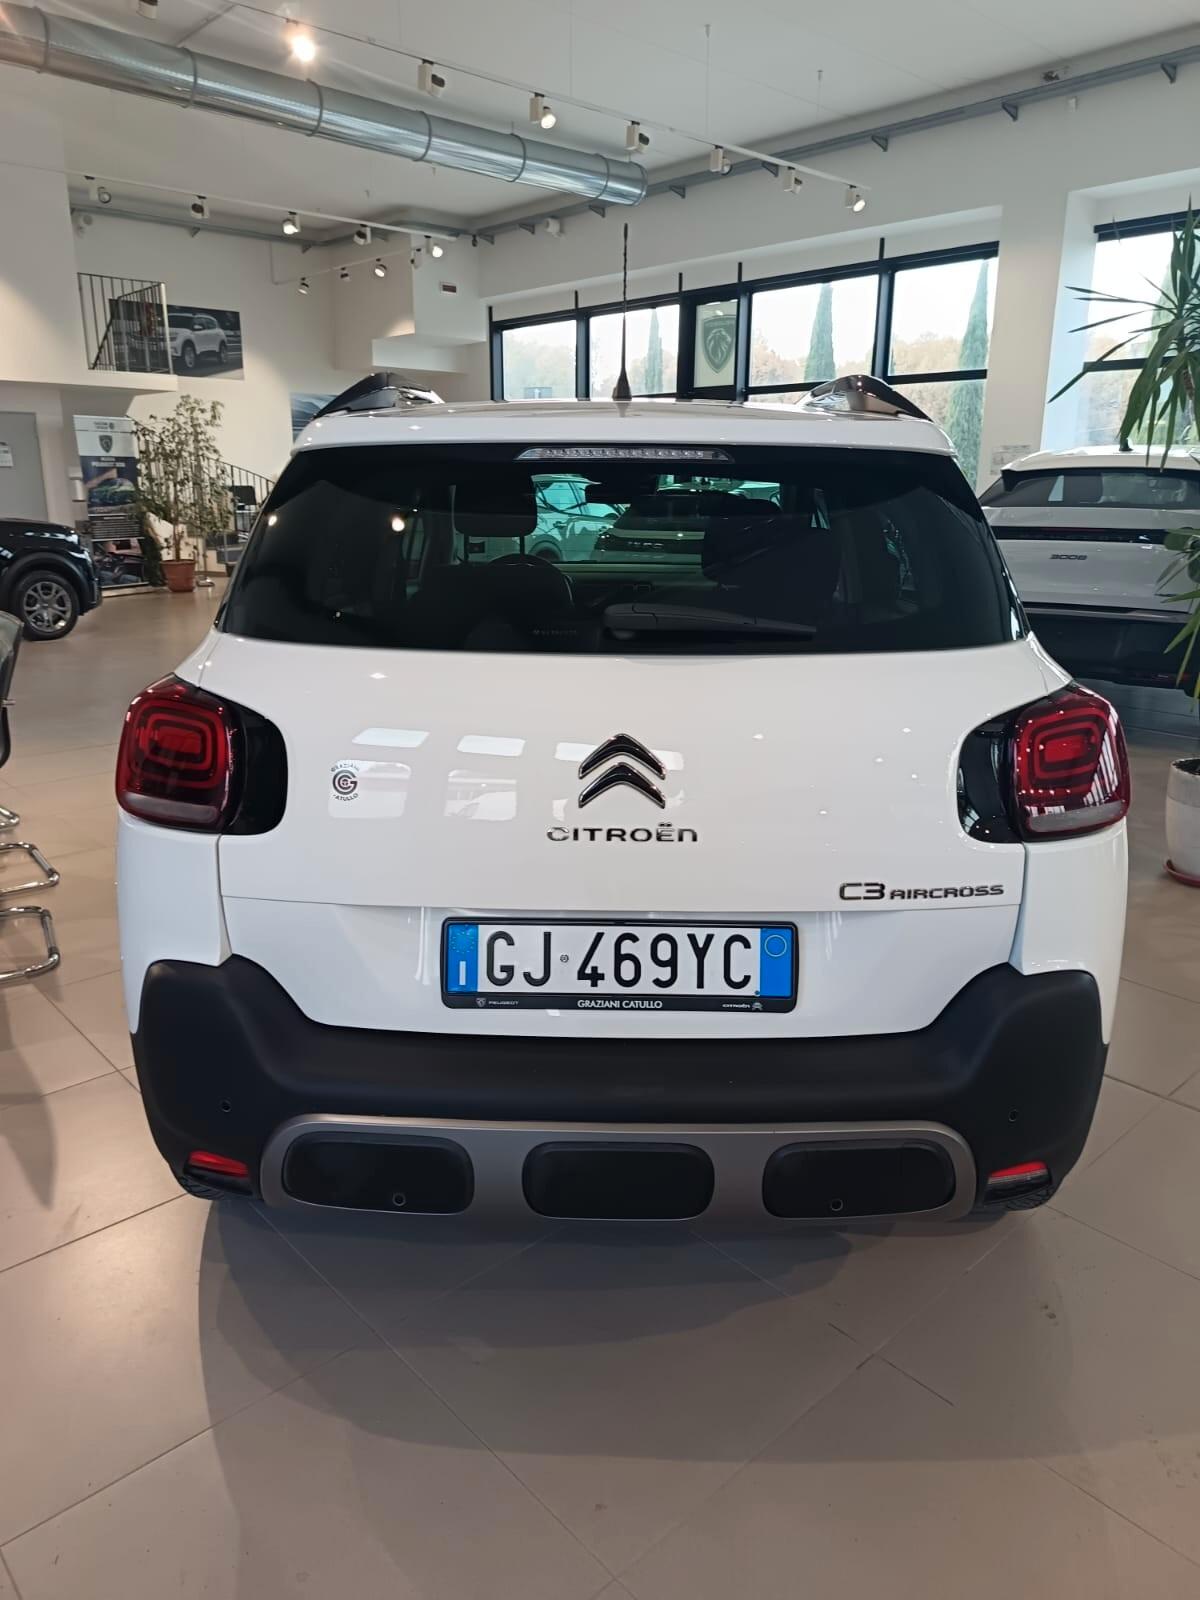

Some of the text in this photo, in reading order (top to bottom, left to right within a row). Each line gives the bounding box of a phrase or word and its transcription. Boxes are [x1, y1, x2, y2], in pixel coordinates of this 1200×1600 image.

[839, 882, 1005, 901] C3 AIRCROSS
[577, 999, 663, 1010] GRAZIANI CATULLO
